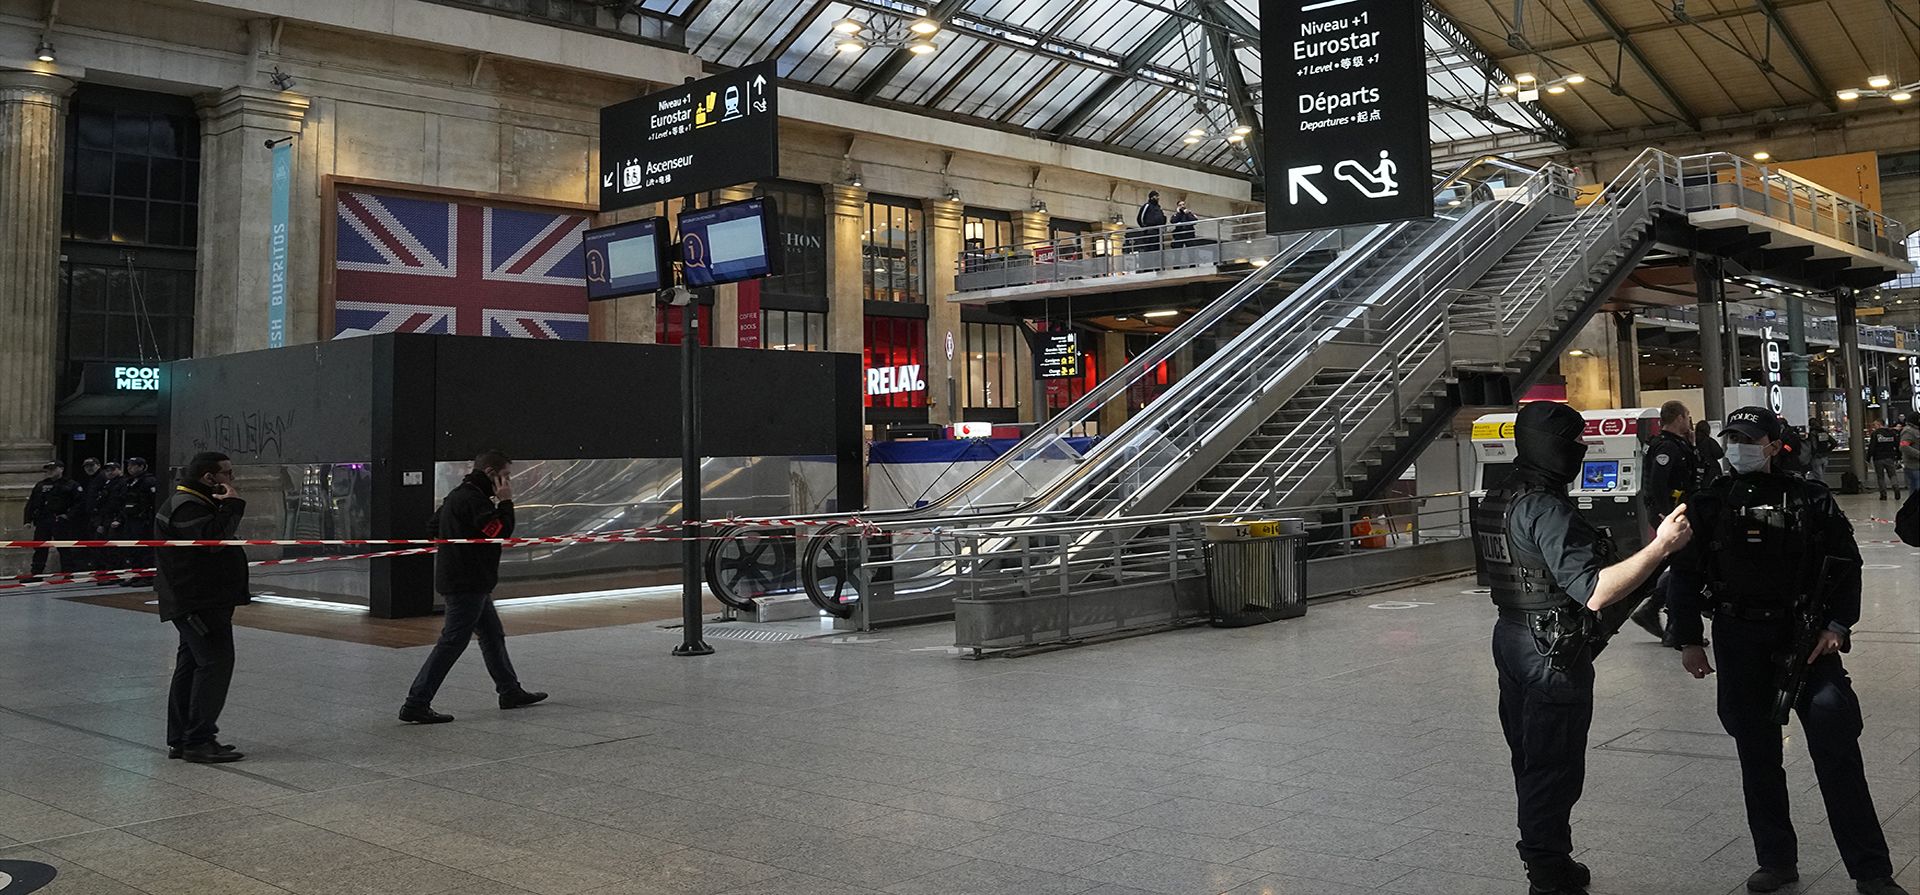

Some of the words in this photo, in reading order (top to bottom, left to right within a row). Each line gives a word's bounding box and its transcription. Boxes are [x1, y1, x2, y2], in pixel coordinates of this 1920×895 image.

[1301, 18, 1348, 37] Niveau
[1351, 11, 1368, 26] +1
[1293, 31, 1380, 60] Eurostar
[1297, 66, 1308, 76] +1
[1309, 62, 1333, 75] Level
[1368, 53, 1379, 65] +1
[658, 98, 682, 111] Niveau
[682, 93, 691, 104] +1
[1299, 86, 1380, 115] Départs
[651, 109, 691, 129] Eurostar
[1300, 116, 1349, 131] Departures
[1357, 109, 1381, 123] 起点
[655, 129, 668, 140] Level
[646, 154, 693, 175] Ascenseur
[646, 178, 655, 187] Lift
[272, 223, 285, 306] BURRITOS
[1730, 413, 1759, 423] POLICE
